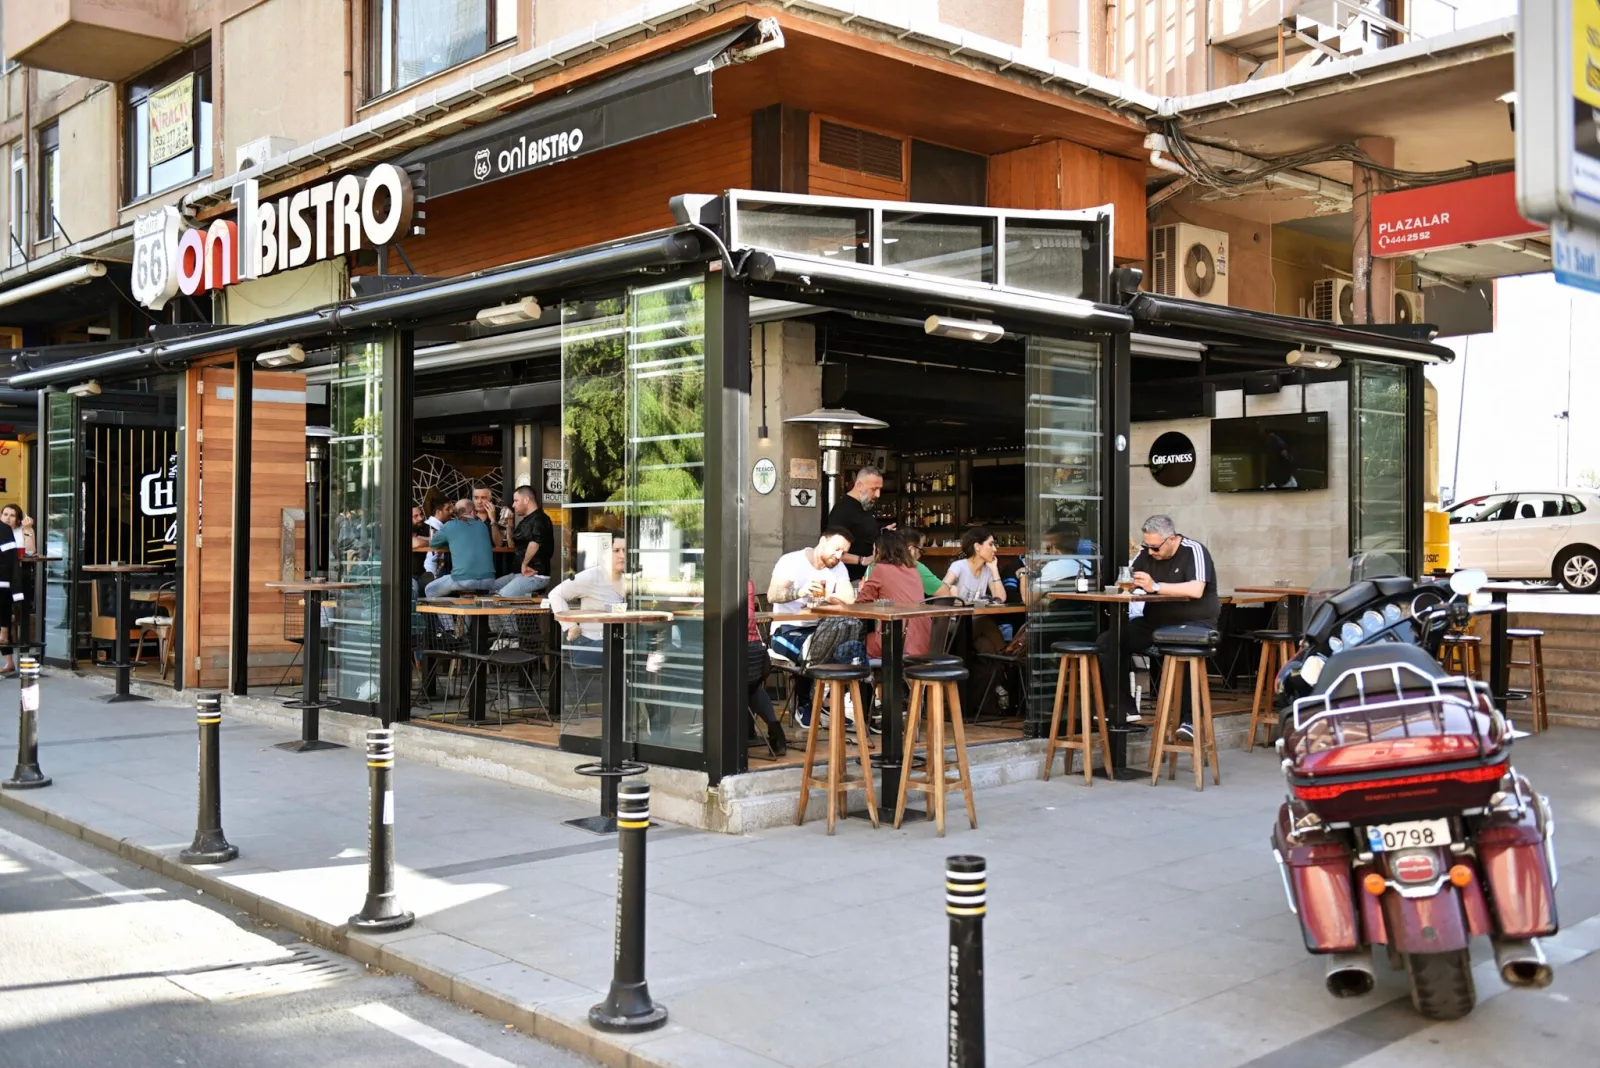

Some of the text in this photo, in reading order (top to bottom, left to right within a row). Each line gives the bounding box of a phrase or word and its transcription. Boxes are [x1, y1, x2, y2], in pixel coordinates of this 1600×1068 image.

[528, 128, 584, 166] BISTRO
[477, 161, 487, 175] 66
[254, 163, 403, 277] BISTRO
[1379, 212, 1450, 234] PLAZALAR
[1390, 231, 1431, 244] 444 25 52
[137, 239, 162, 290] 66
[1152, 454, 1193, 465] GREATNESS
[550, 481, 563, 490] 66
[1384, 828, 1435, 848] 0798
